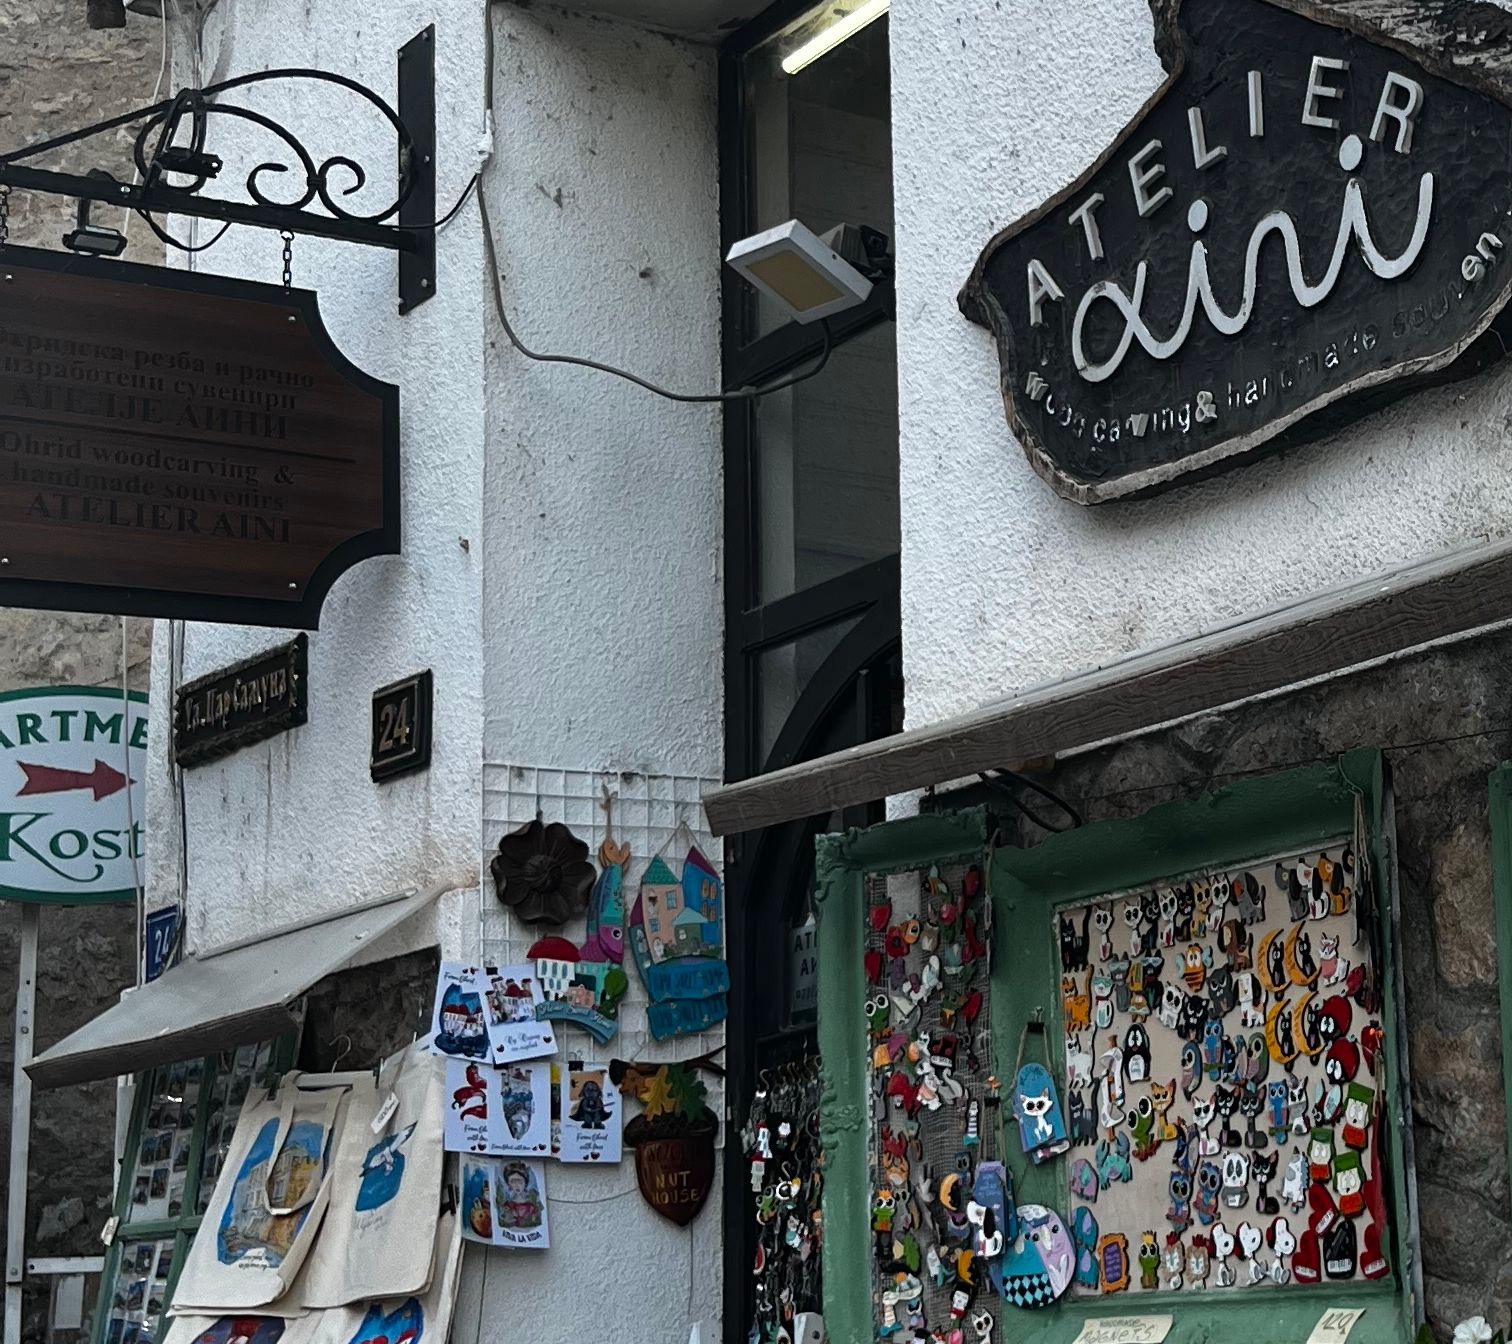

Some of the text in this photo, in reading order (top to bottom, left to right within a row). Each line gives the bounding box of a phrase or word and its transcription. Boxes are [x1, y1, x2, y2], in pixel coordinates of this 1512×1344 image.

[1026, 56, 1425, 327] ATELIER
[1071, 134, 1434, 383] aini
[3, 356, 297, 411] изработени сувенири
[134, 350, 204, 373] резба
[215, 360, 229, 376] и
[239, 364, 314, 389] рачно
[10, 382, 288, 440] АТЕЛЈЕ АИНИ
[1, 430, 296, 485] Ohrid woodcarving &
[10, 461, 284, 512] handmade souvenirs
[26, 492, 291, 544] ATELIER AINI
[380, 697, 410, 753] 24
[652, 1189, 700, 1205] HOUSE
[656, 1171, 691, 1189] NUT
[1321, 1312, 1354, 1330] 120
